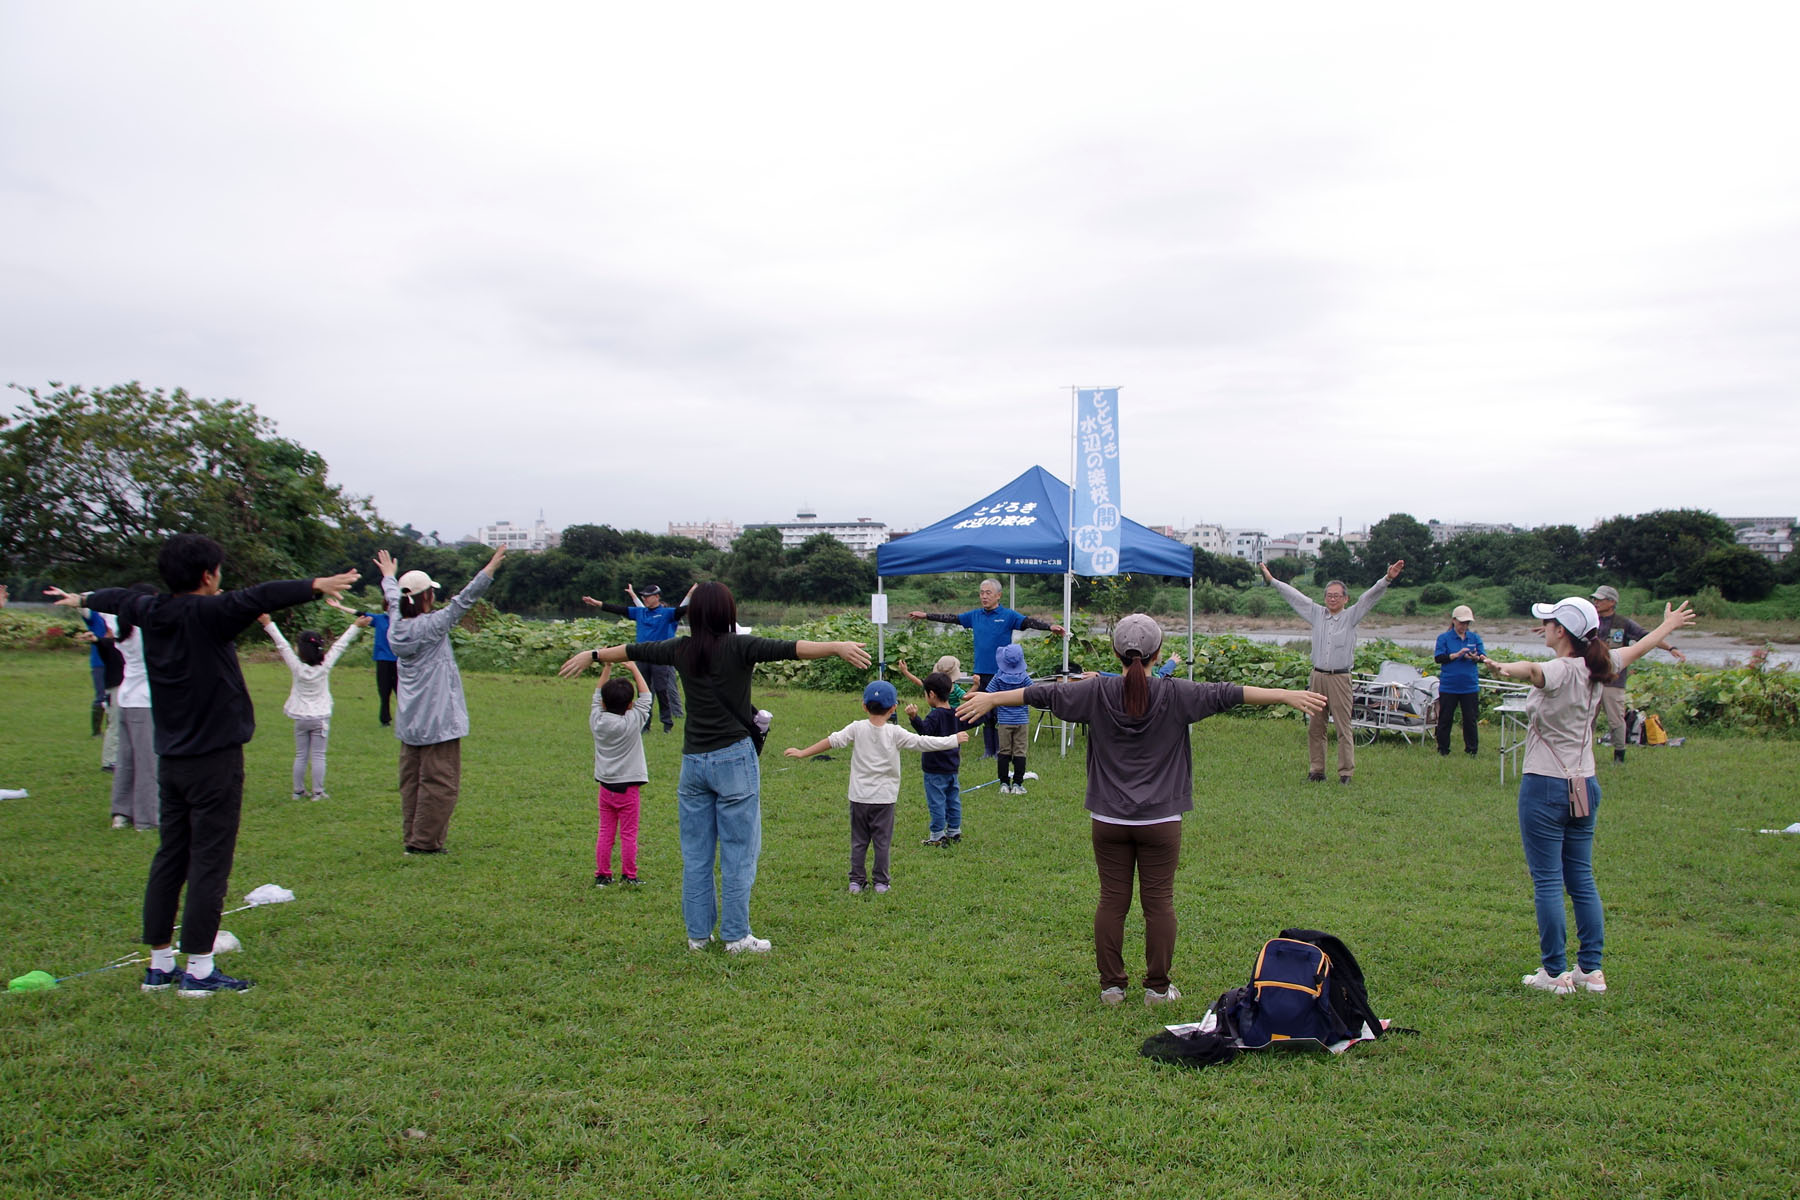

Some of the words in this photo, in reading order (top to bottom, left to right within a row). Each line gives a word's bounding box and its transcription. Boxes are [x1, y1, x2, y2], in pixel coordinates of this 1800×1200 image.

[1079, 415, 1110, 505] 水辺の楽校
[952, 515, 1037, 530] 水辺の楽校
[973, 501, 1037, 516] とどろき
[1079, 506, 1117, 570] 開校中
